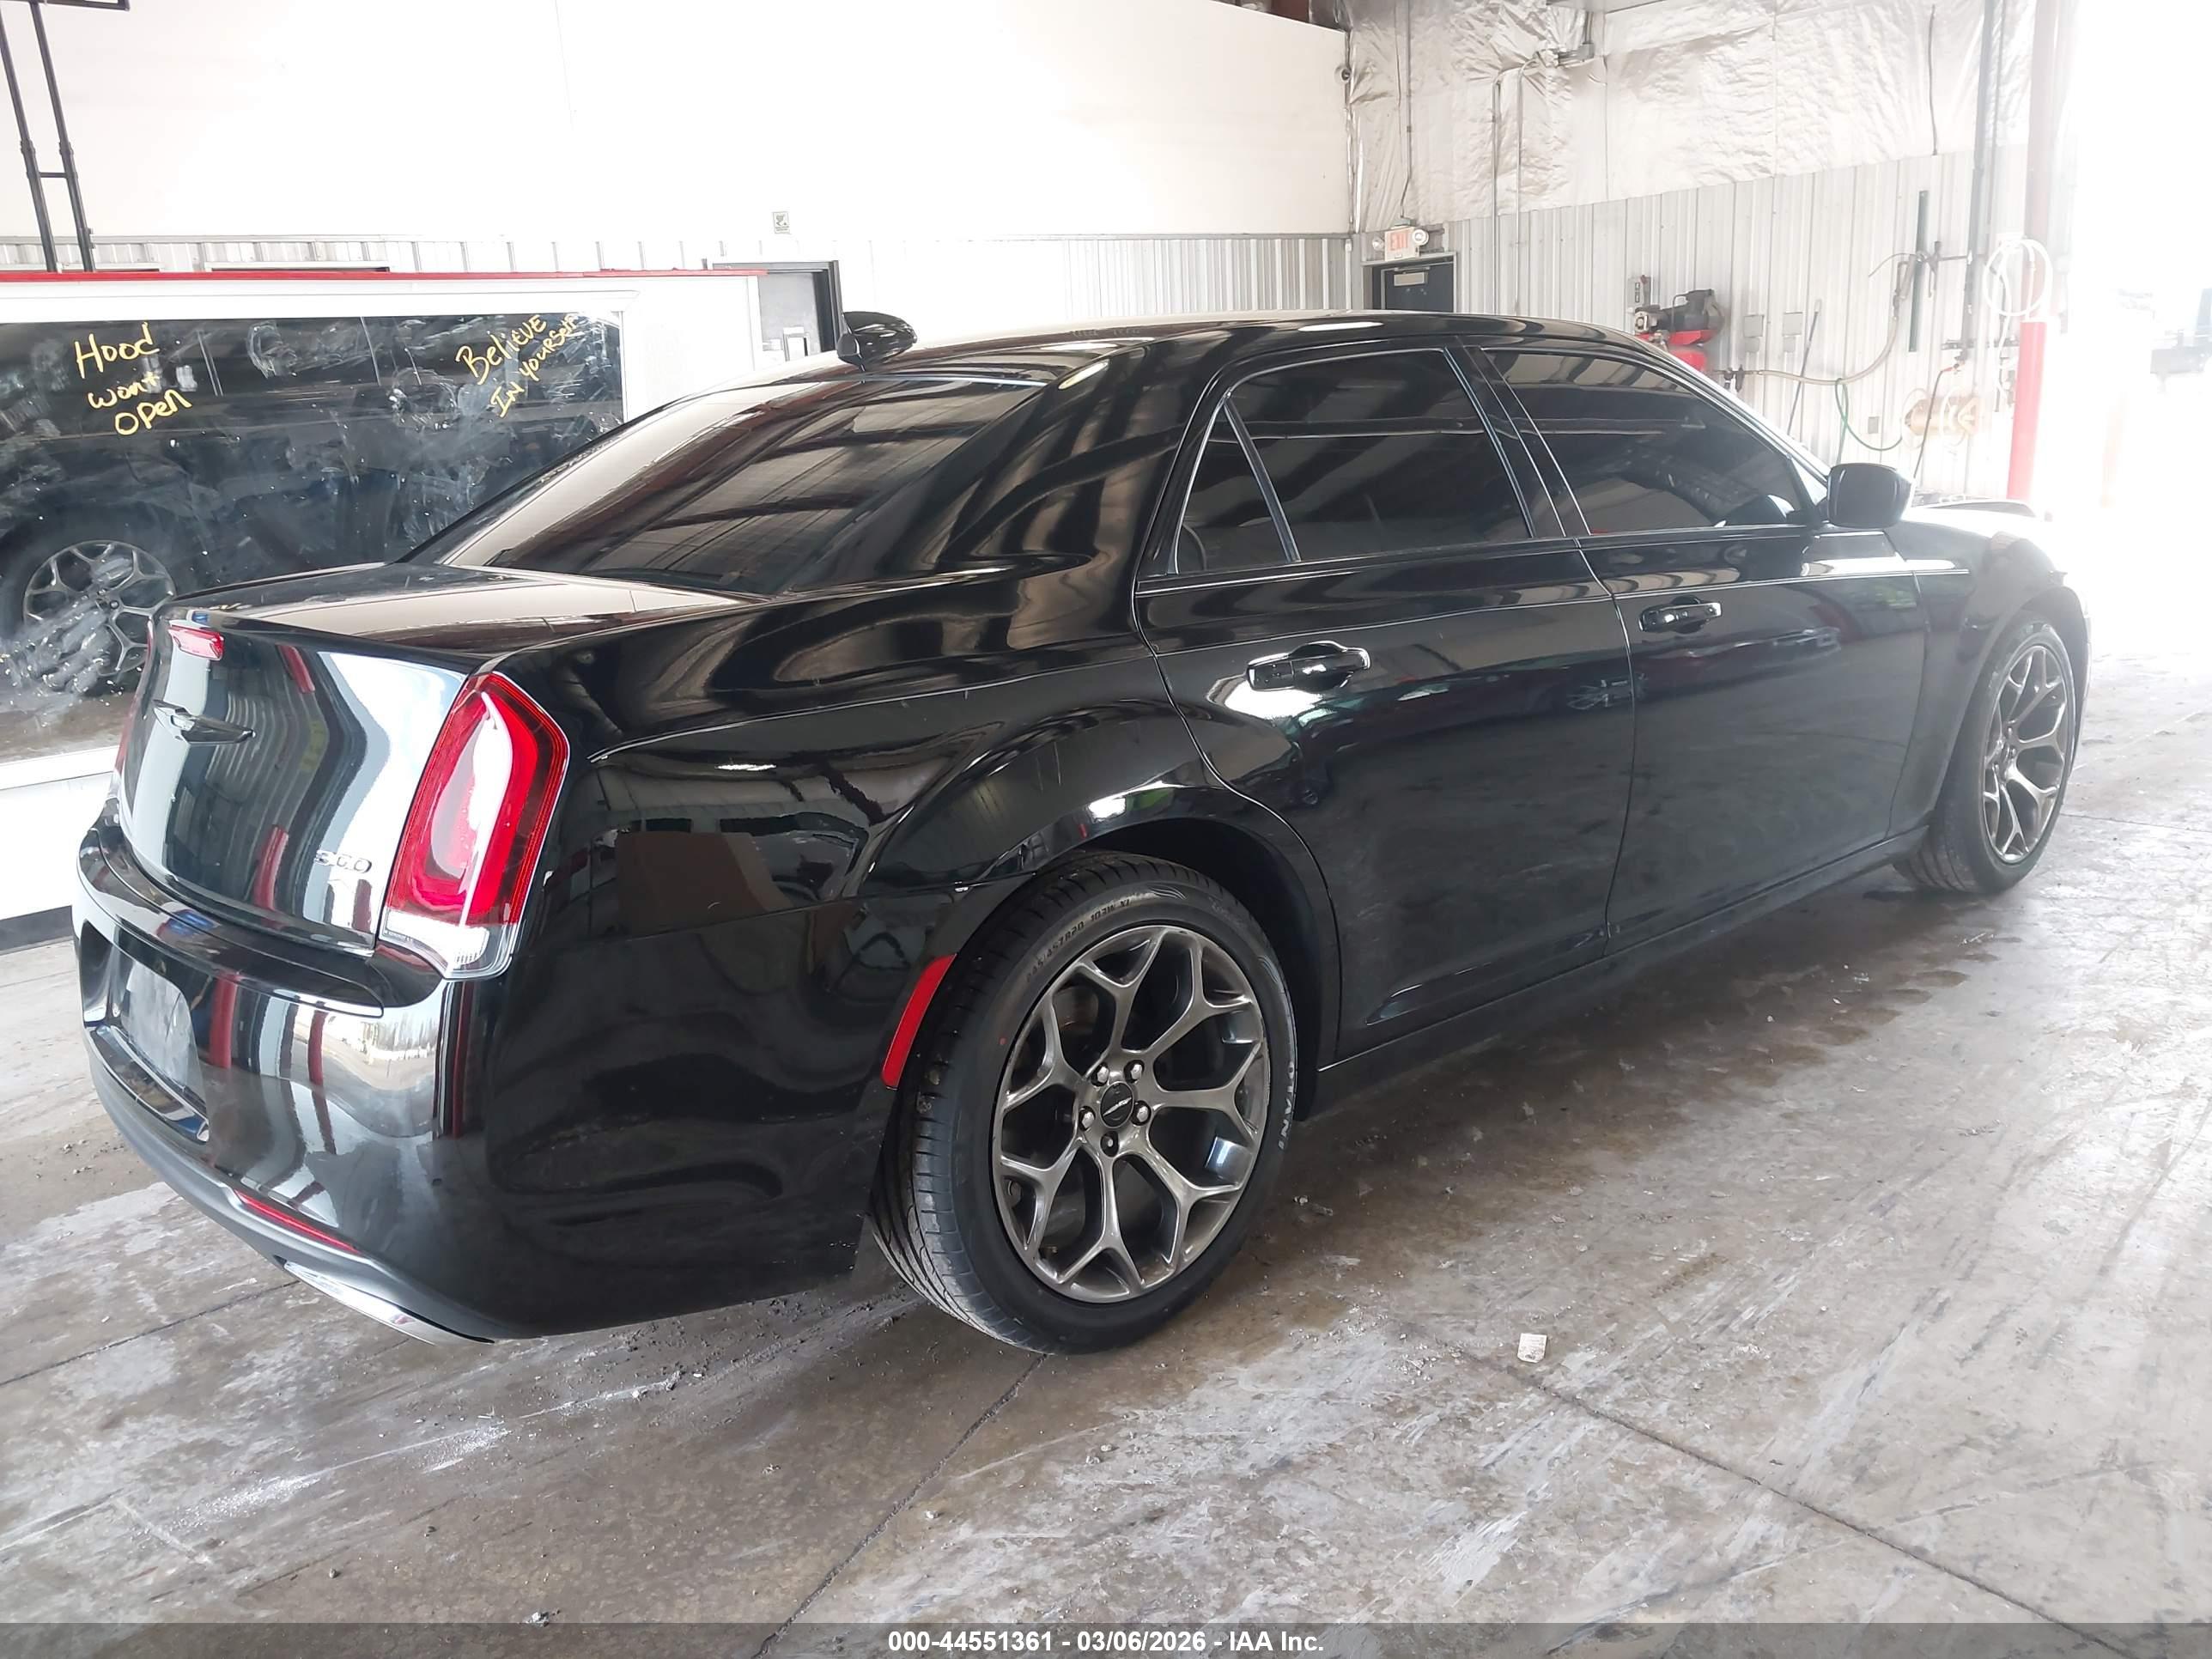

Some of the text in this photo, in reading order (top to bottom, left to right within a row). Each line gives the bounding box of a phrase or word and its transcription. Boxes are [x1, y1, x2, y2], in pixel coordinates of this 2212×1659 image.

[74, 321, 161, 380] Hood
[314, 849, 372, 873] 300
[1278, 1060, 1295, 1151] OTANI
